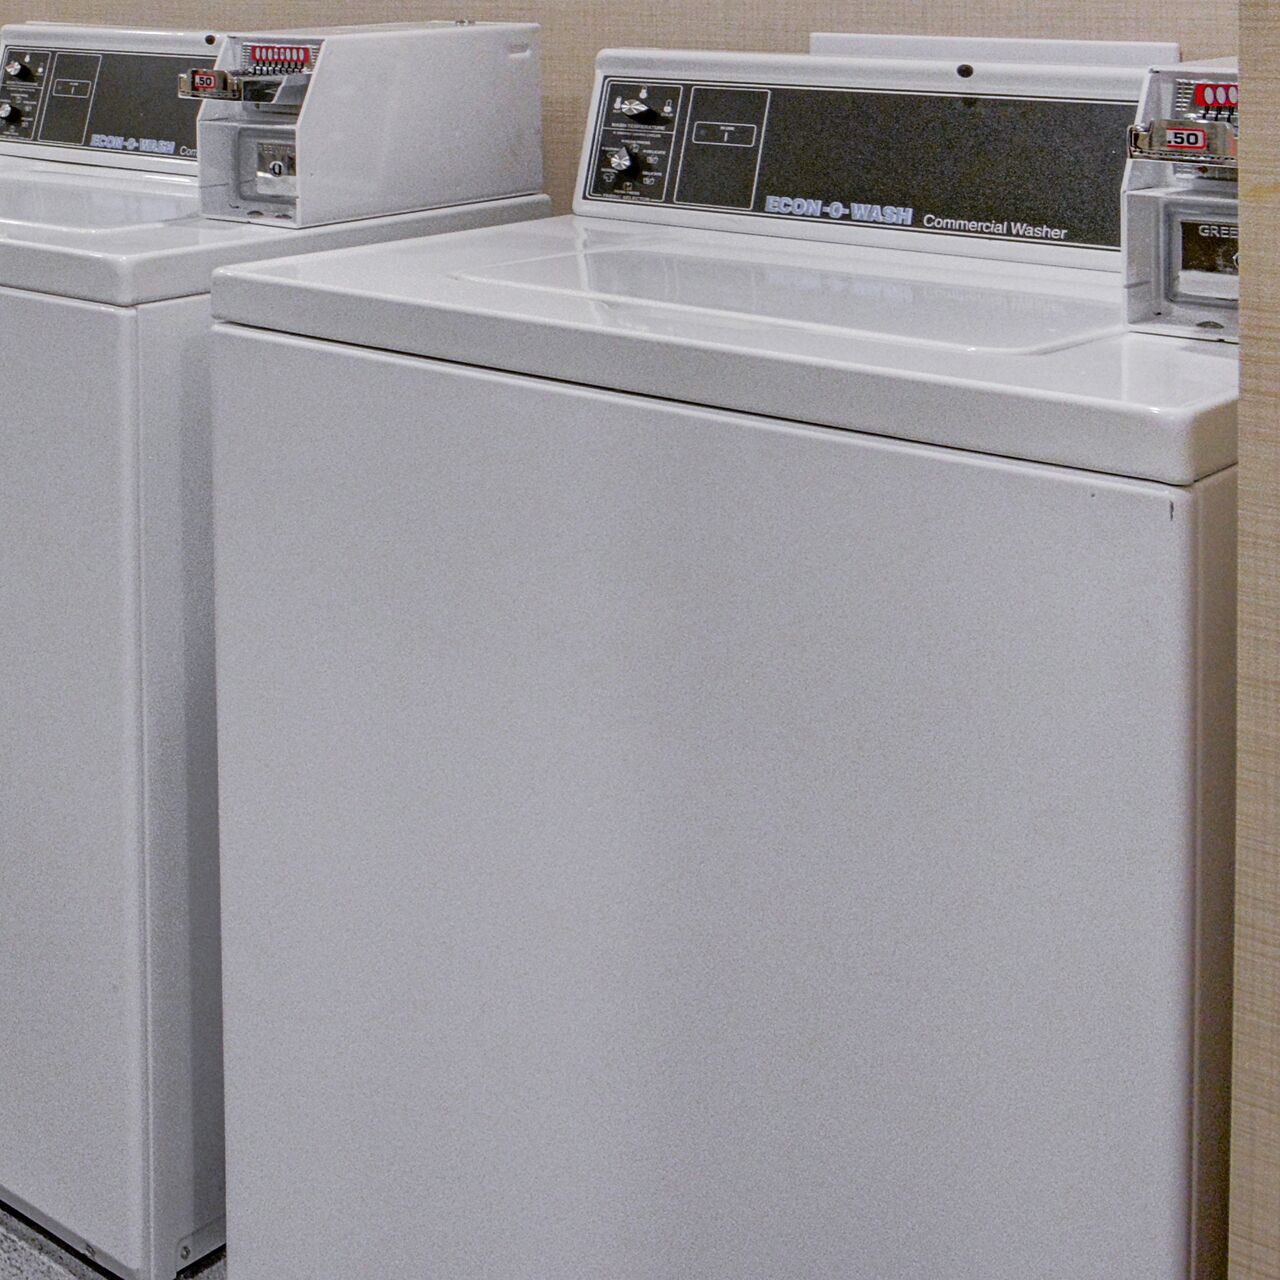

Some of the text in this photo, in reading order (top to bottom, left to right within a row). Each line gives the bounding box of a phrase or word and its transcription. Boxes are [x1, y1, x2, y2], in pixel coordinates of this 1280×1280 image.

[1168, 132, 1198, 145] .50
[923, 214, 1008, 235] Commercial
[1010, 222, 1068, 240] Washer
